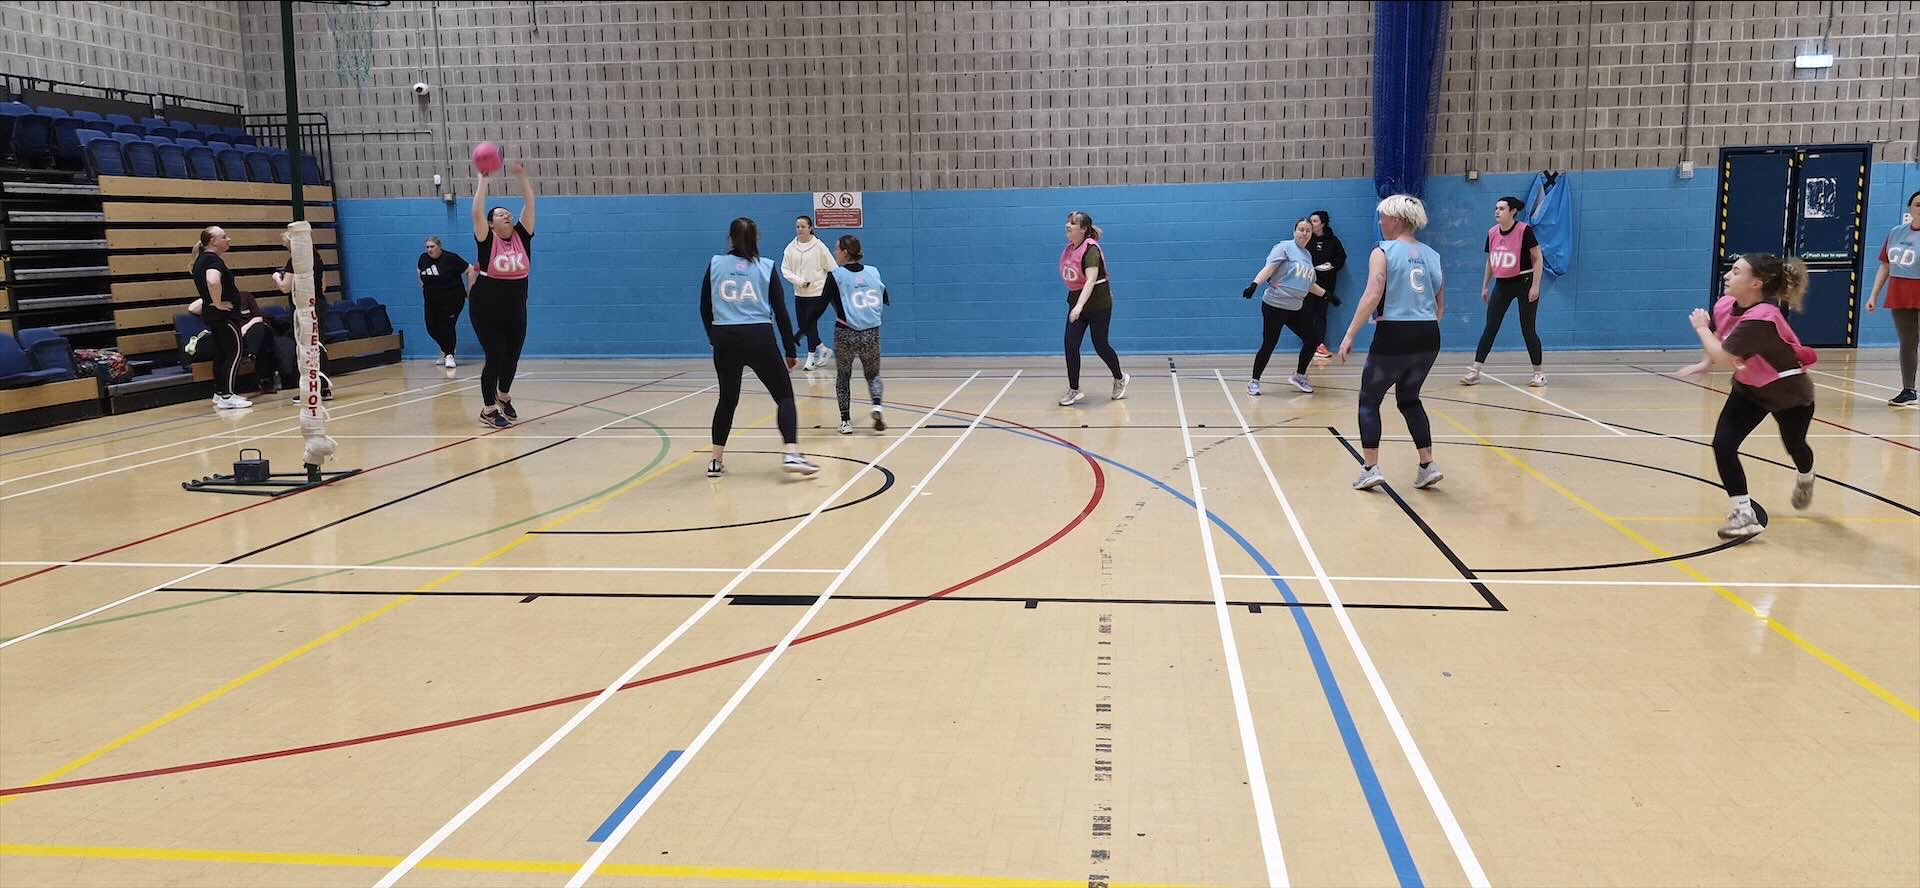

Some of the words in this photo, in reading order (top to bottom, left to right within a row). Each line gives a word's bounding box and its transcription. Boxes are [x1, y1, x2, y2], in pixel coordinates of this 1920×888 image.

[494, 253, 525, 272] GK
[1490, 251, 1517, 269] WD
[719, 279, 758, 303] GA
[1409, 268, 1425, 292] C
[852, 289, 880, 309] GS
[308, 298, 320, 346] SURE
[308, 369, 318, 417] SHOT
